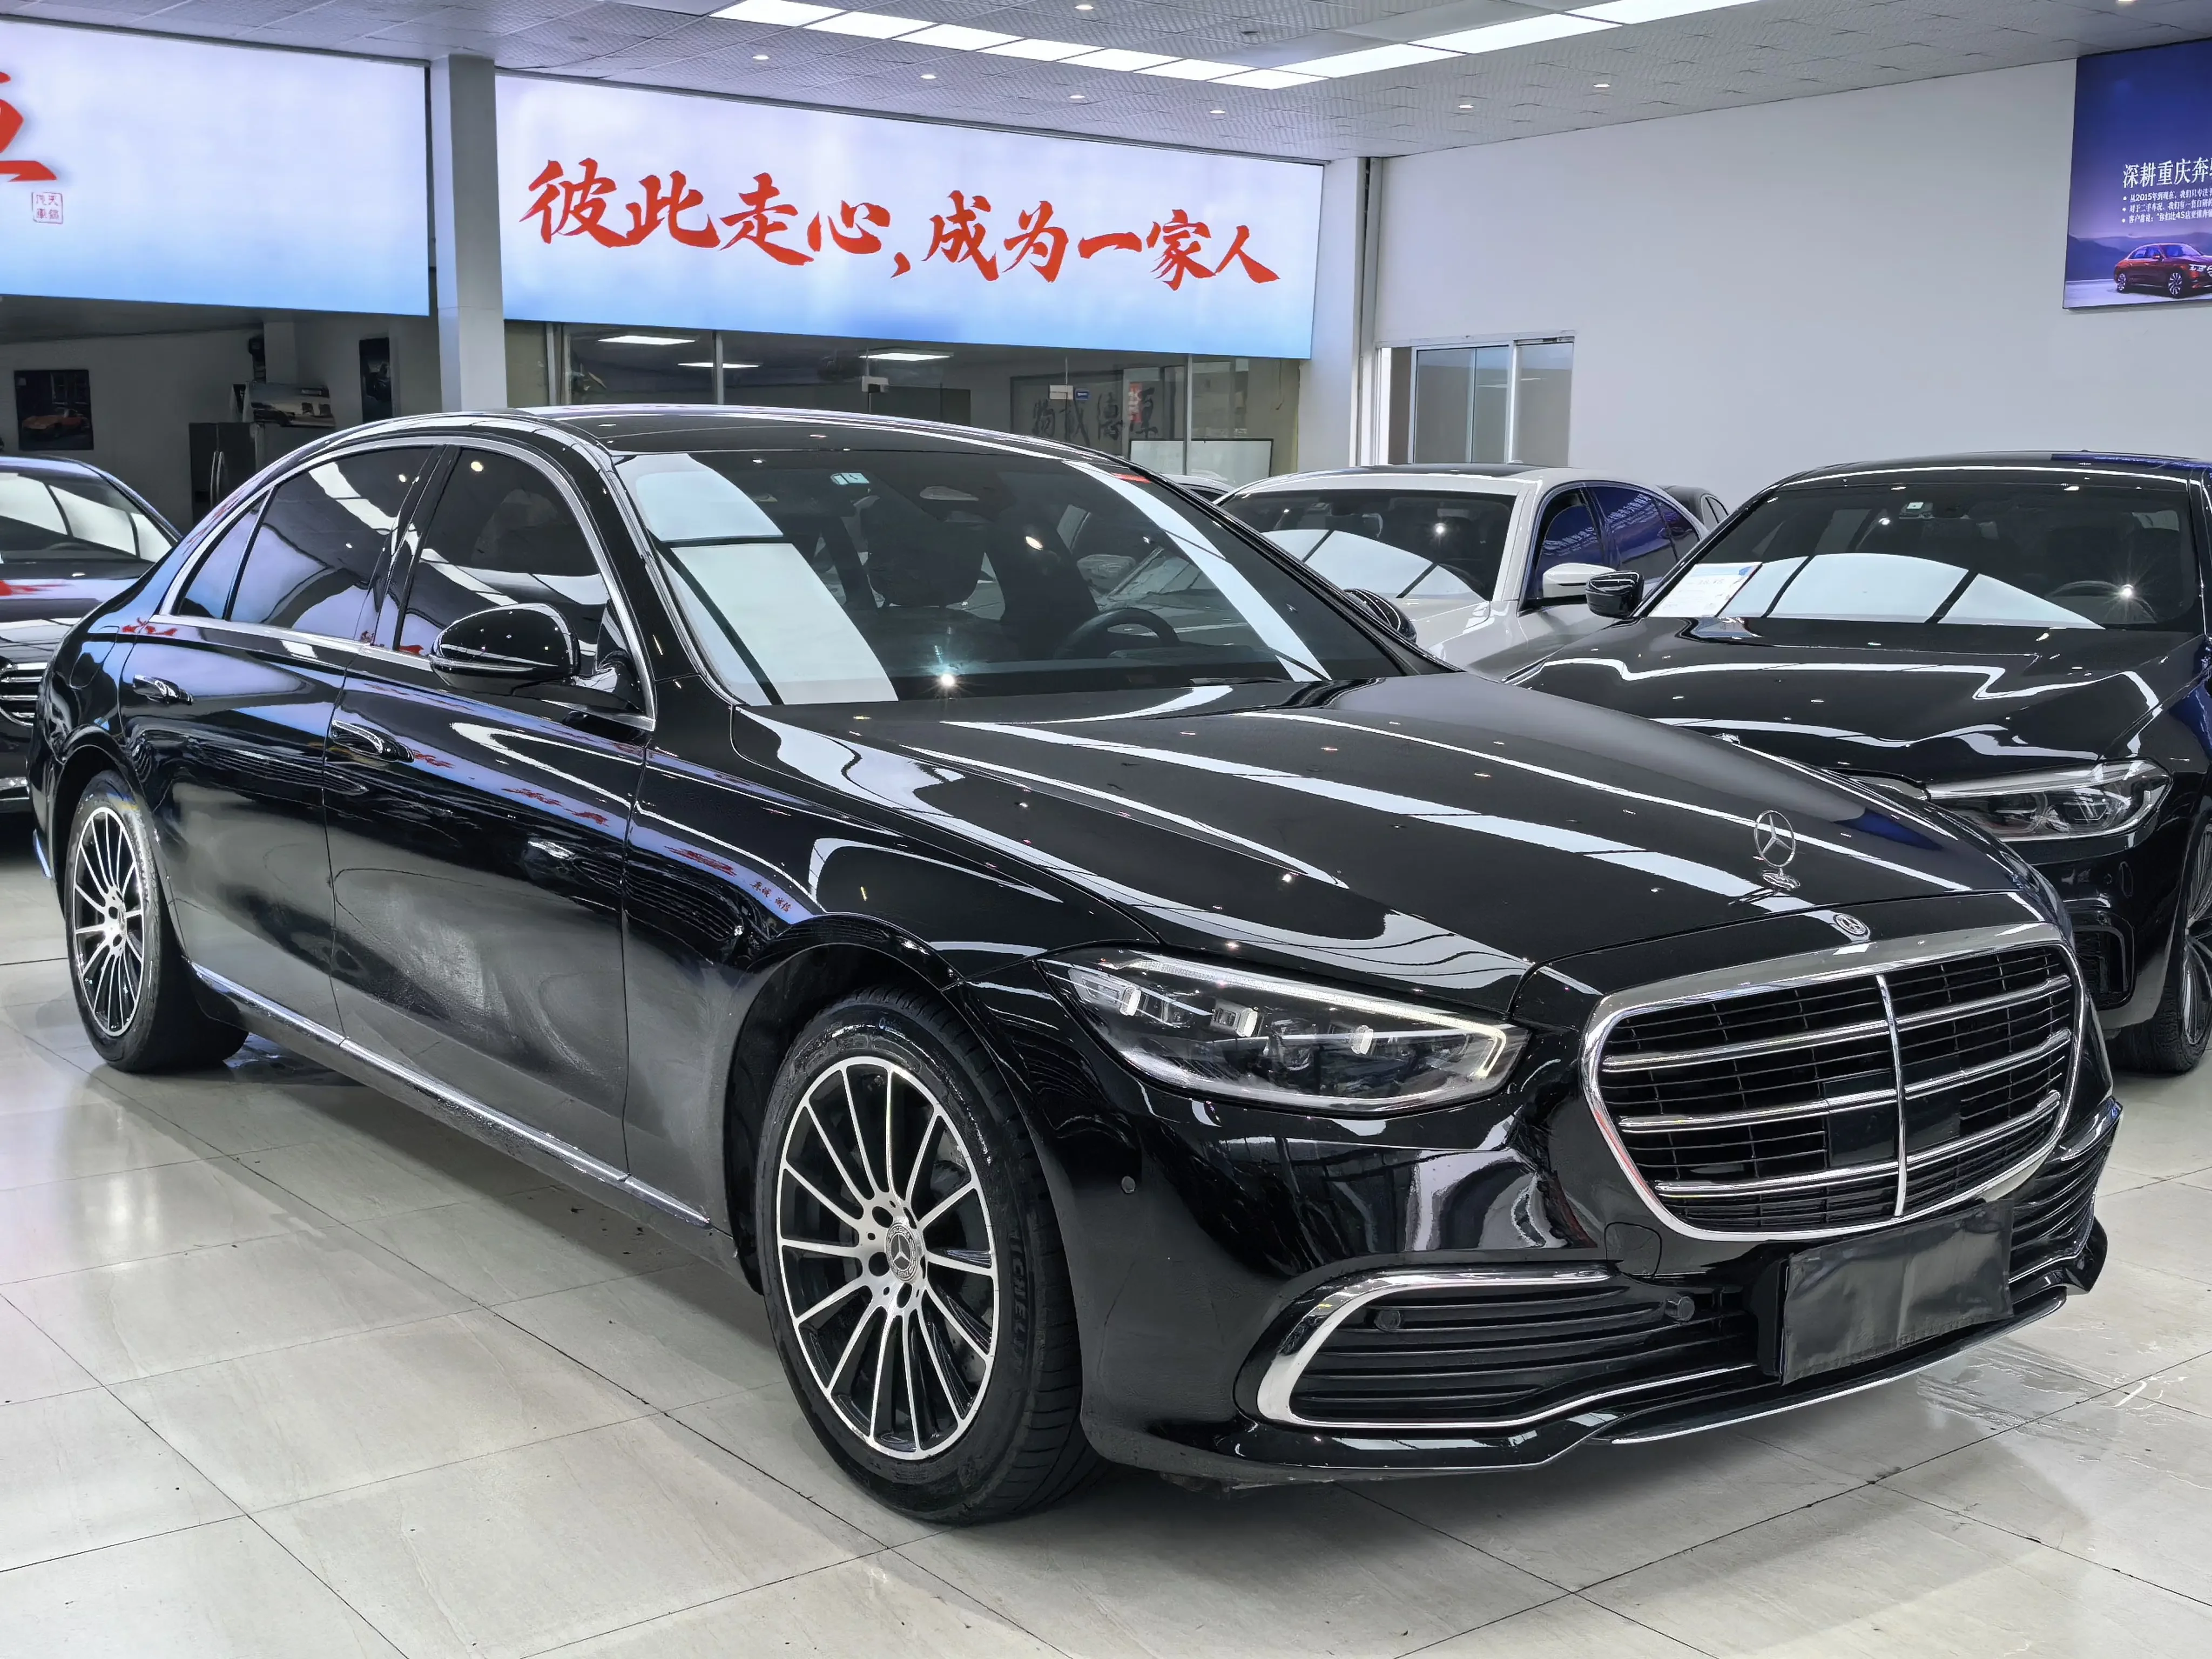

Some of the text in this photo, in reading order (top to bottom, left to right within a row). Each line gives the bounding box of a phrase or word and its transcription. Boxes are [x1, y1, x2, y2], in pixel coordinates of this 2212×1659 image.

[520, 158, 1280, 291] 彼此走心，成为一家人
